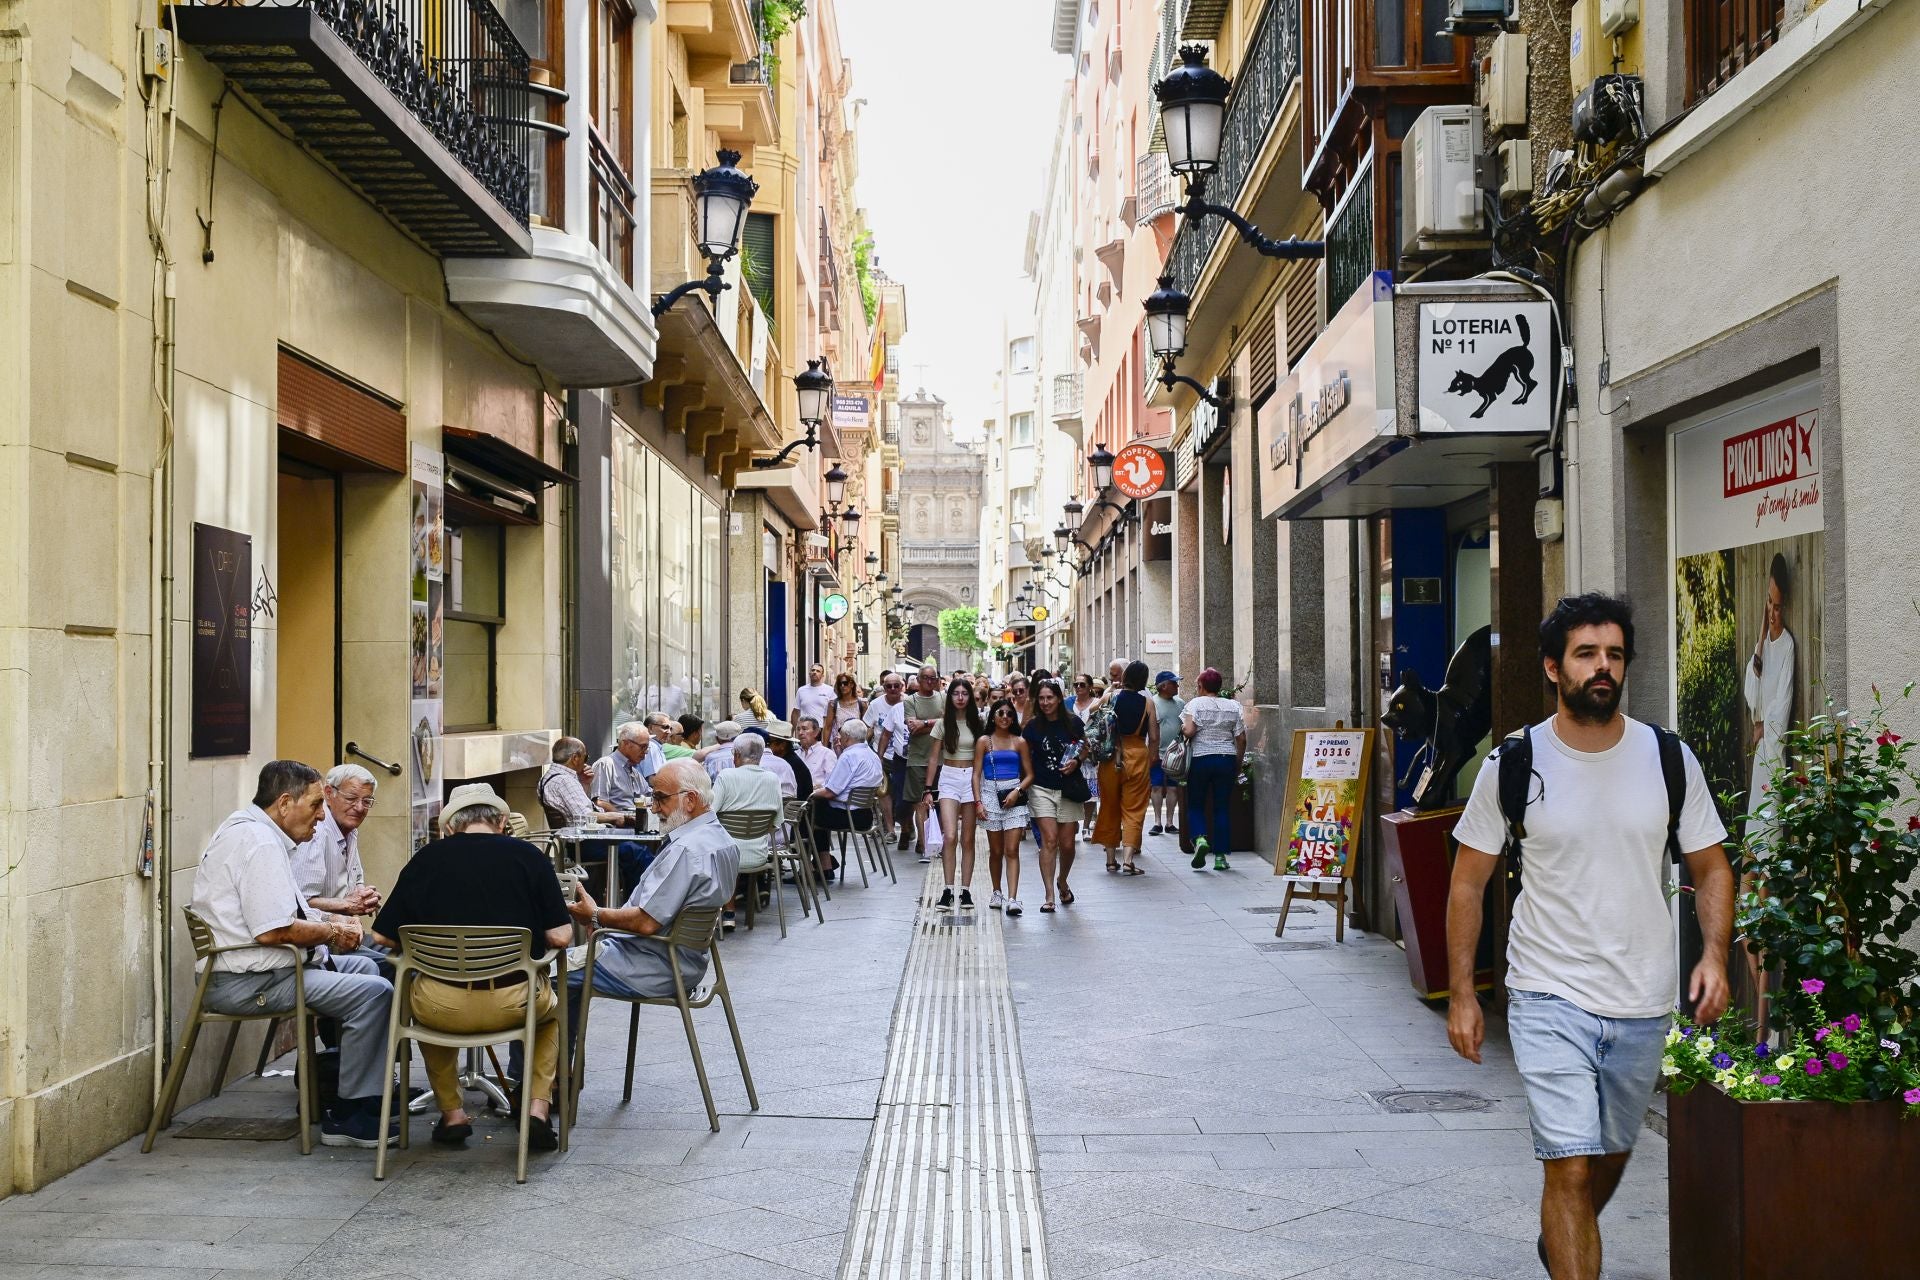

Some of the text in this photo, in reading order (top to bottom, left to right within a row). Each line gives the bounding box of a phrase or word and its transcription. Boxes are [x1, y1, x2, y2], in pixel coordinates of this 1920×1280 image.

[1432, 319, 1512, 335] LOTERIA
[1432, 339, 1475, 354] Nº 11
[1122, 448, 1156, 460] POPEYES
[1727, 425, 1793, 491] PIKOLINOS
[1121, 482, 1157, 496] CHICKEN
[1756, 491, 1770, 528] get
[1769, 487, 1791, 522] comfy
[1799, 479, 1820, 508] smile
[1315, 748, 1351, 757] 30316
[1316, 789, 1337, 807] VA
[1312, 806, 1337, 823] CA
[1300, 841, 1335, 861] NES
